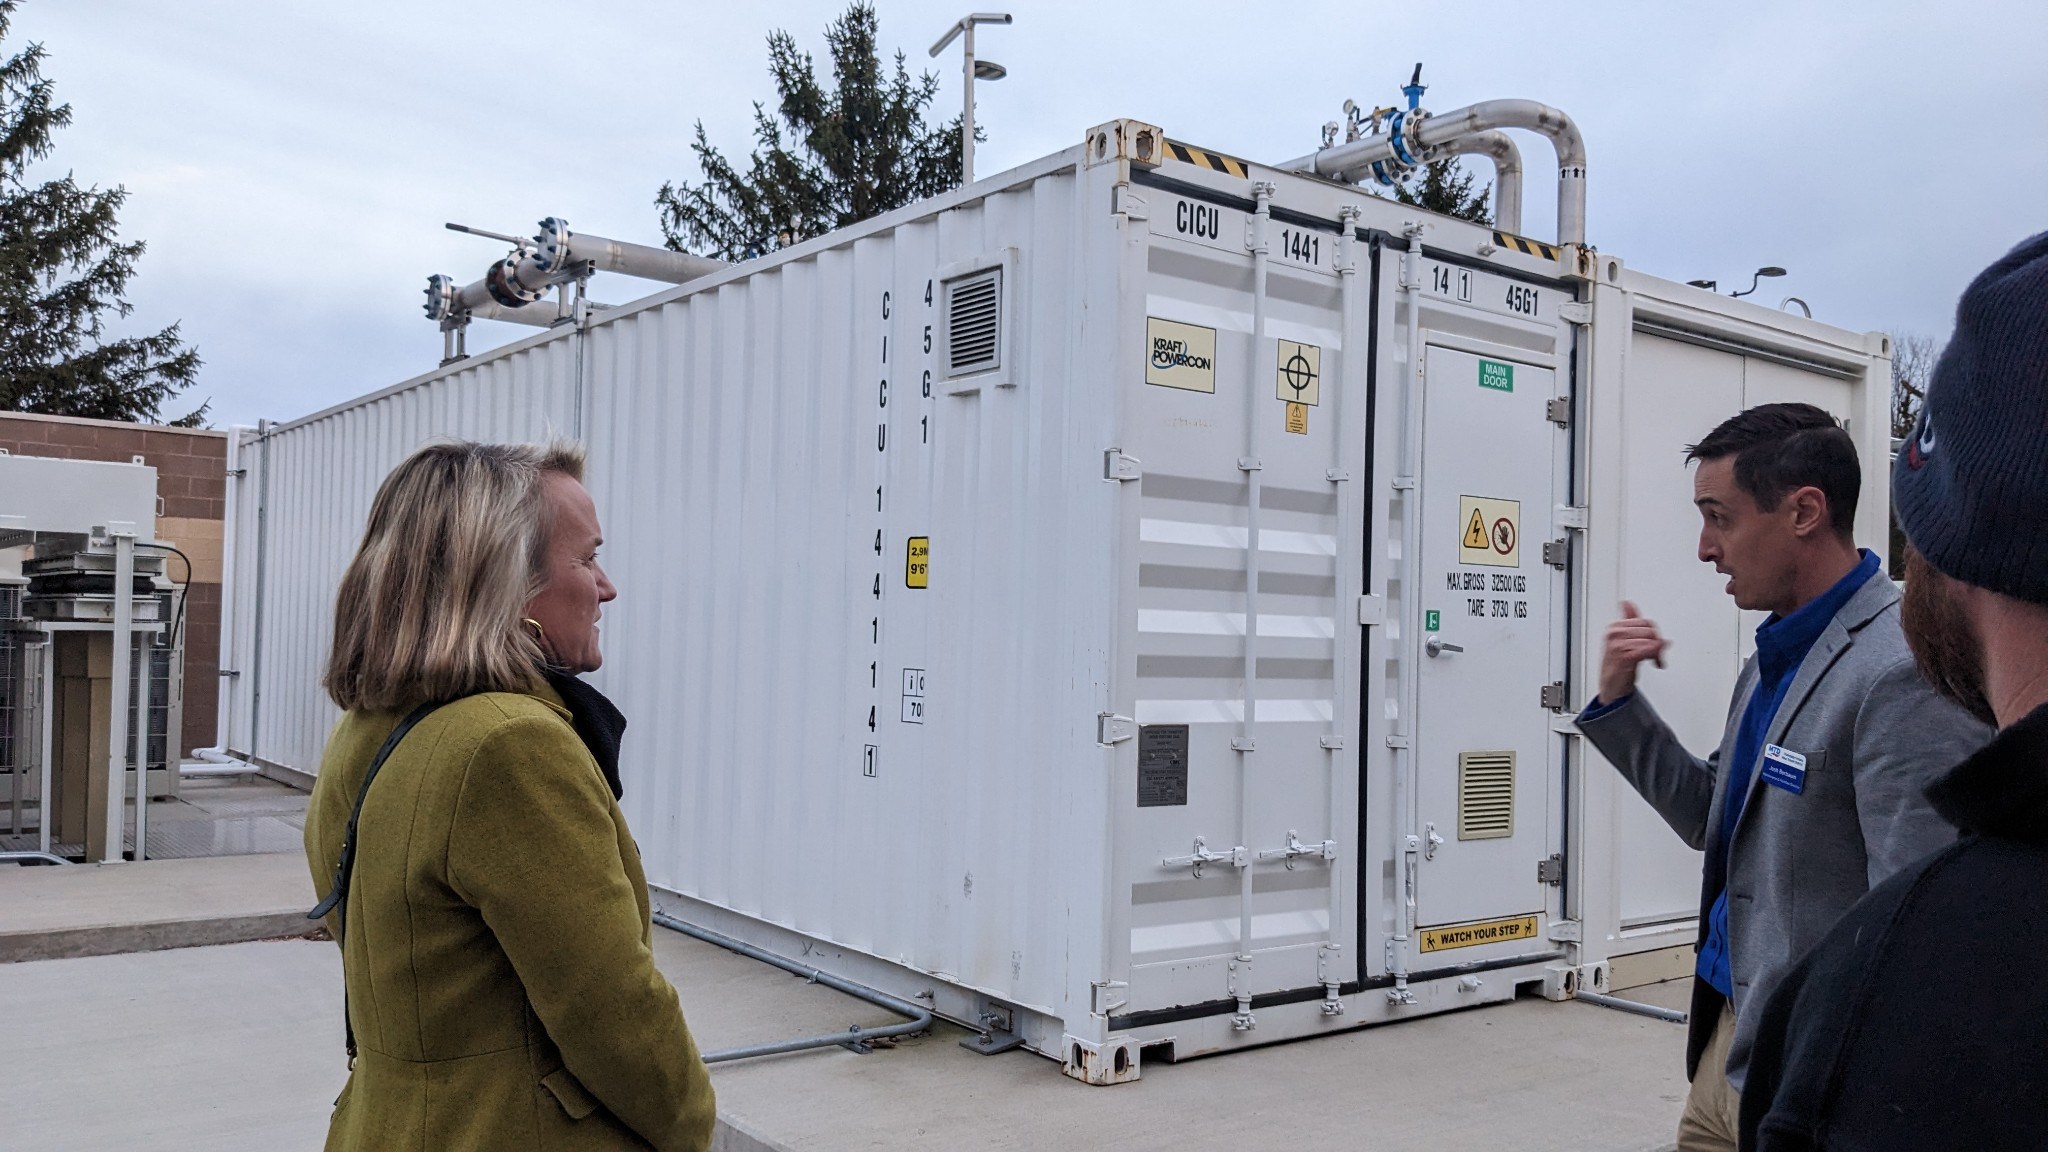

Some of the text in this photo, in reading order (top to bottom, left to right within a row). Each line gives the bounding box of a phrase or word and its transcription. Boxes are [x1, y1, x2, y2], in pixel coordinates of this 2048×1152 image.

[1176, 200, 1319, 265] CICU 1441
[1433, 265, 1449, 294] 14
[1506, 285, 1538, 316] 45G1
[1153, 337, 1183, 353] KRAFT
[921, 280, 933, 444] 45G1
[1153, 350, 1211, 370] POWERCON
[1485, 363, 1506, 377] MAIN
[878, 291, 890, 452] CICU
[1483, 374, 1508, 388] DOOR
[1467, 598, 1528, 618] TARE 3730 KGS
[1440, 924, 1520, 945] WATCH YOUR STEP
